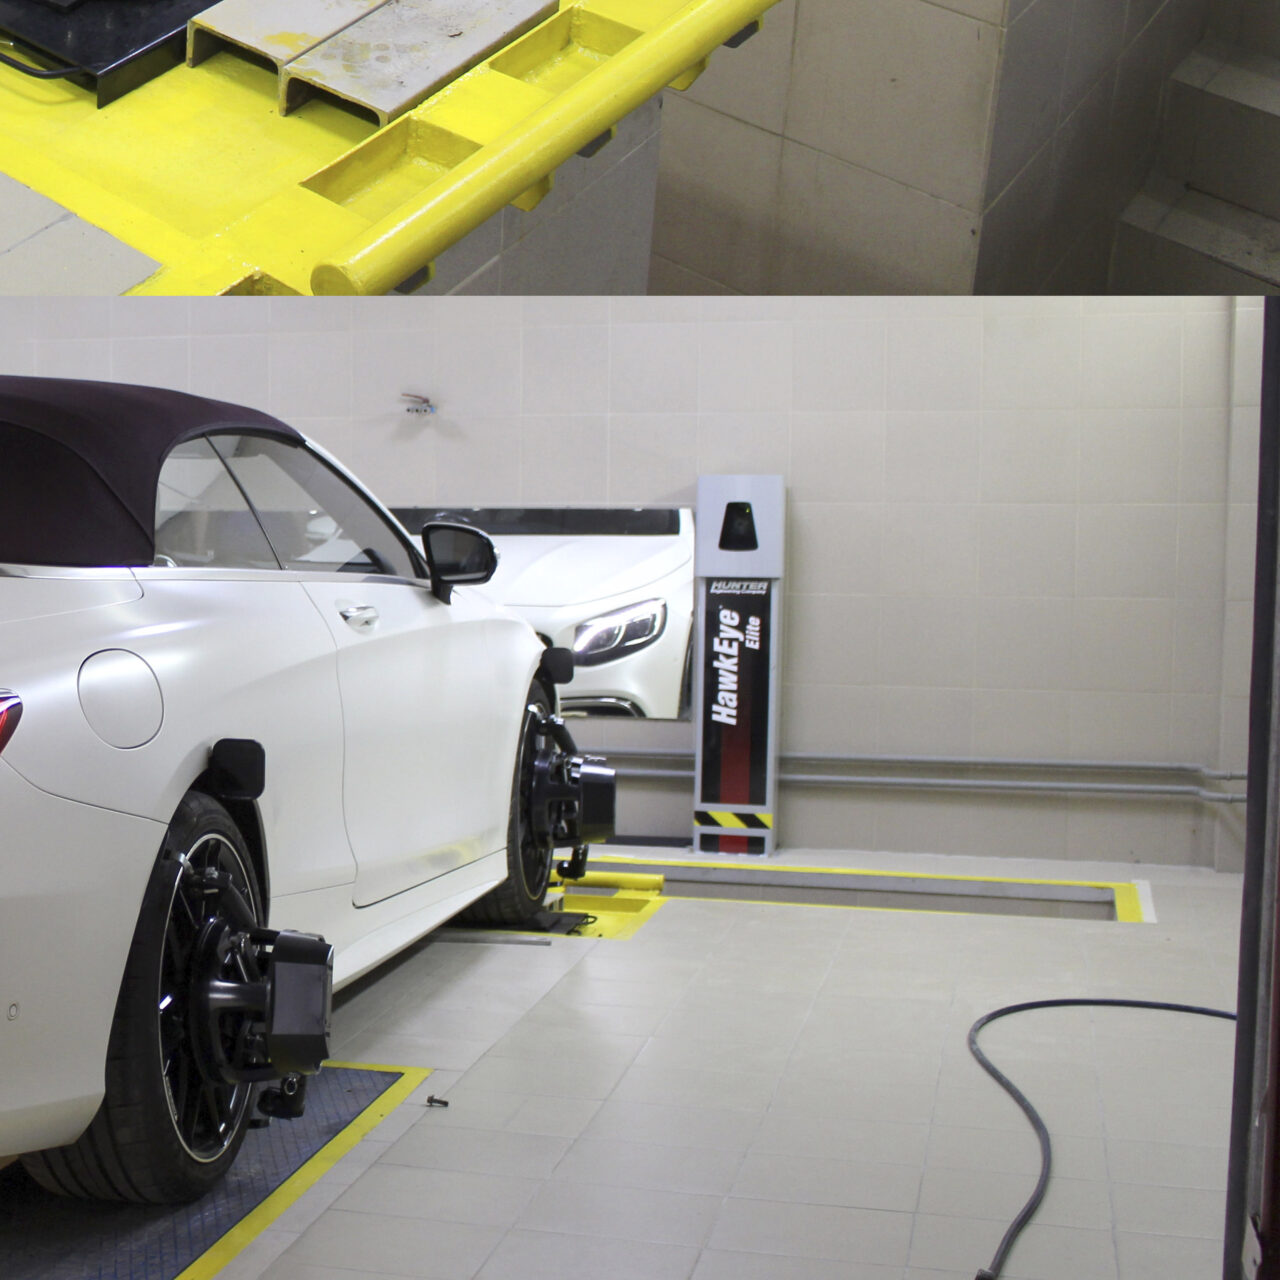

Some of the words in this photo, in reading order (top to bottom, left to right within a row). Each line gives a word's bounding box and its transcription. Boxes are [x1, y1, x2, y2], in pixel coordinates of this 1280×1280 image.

[711, 580, 769, 592] HUNTER
[745, 615, 761, 650] Elite
[712, 608, 744, 726] HawkEye
